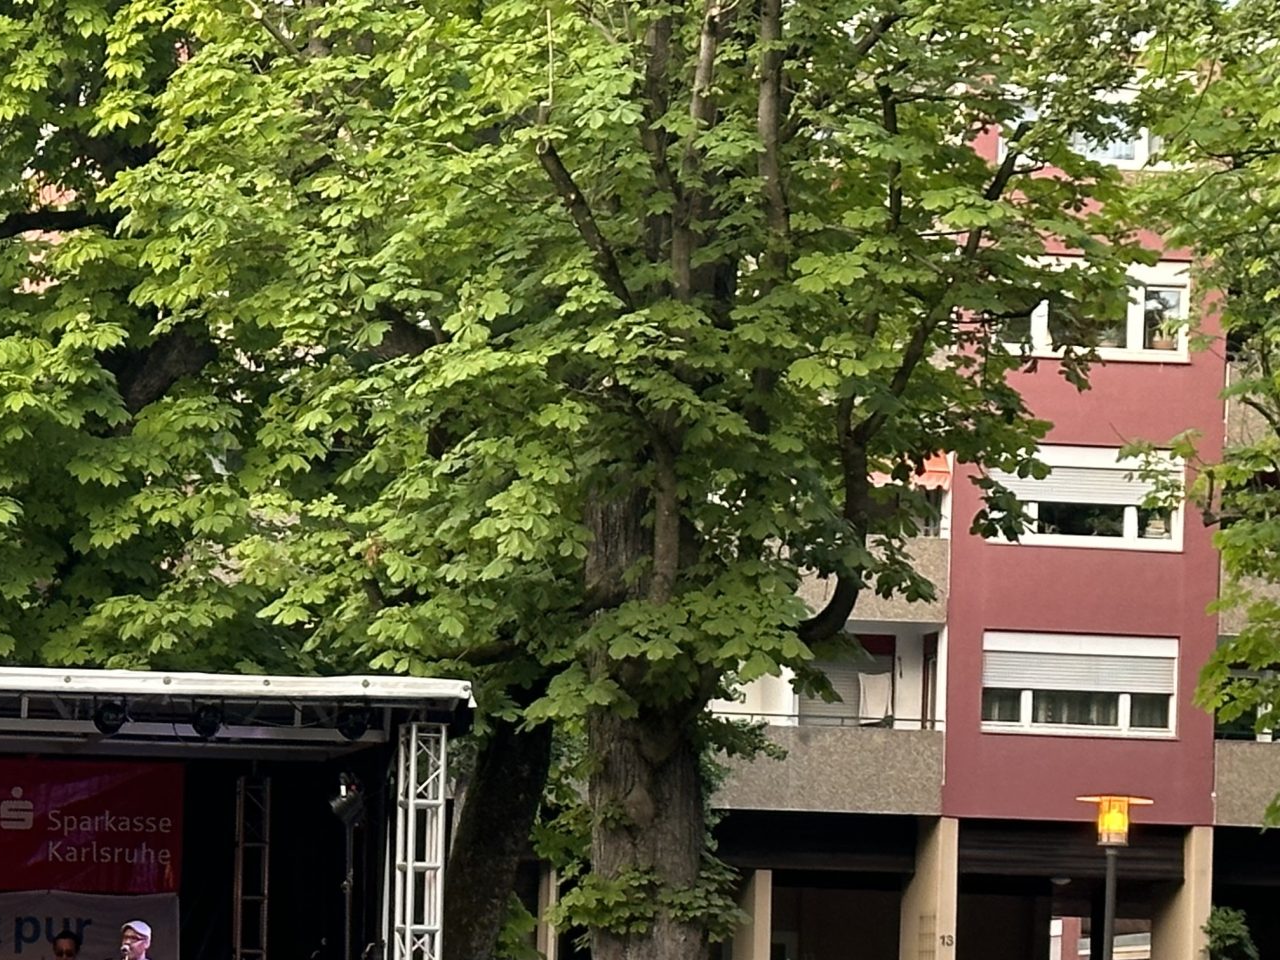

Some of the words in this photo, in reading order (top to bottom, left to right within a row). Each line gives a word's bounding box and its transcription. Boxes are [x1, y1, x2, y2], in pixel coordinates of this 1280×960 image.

[47, 809, 172, 836] Sparkasse
[47, 840, 171, 865] Karlsruhe
[14, 914, 92, 954] pur
[939, 934, 954, 947] 13
